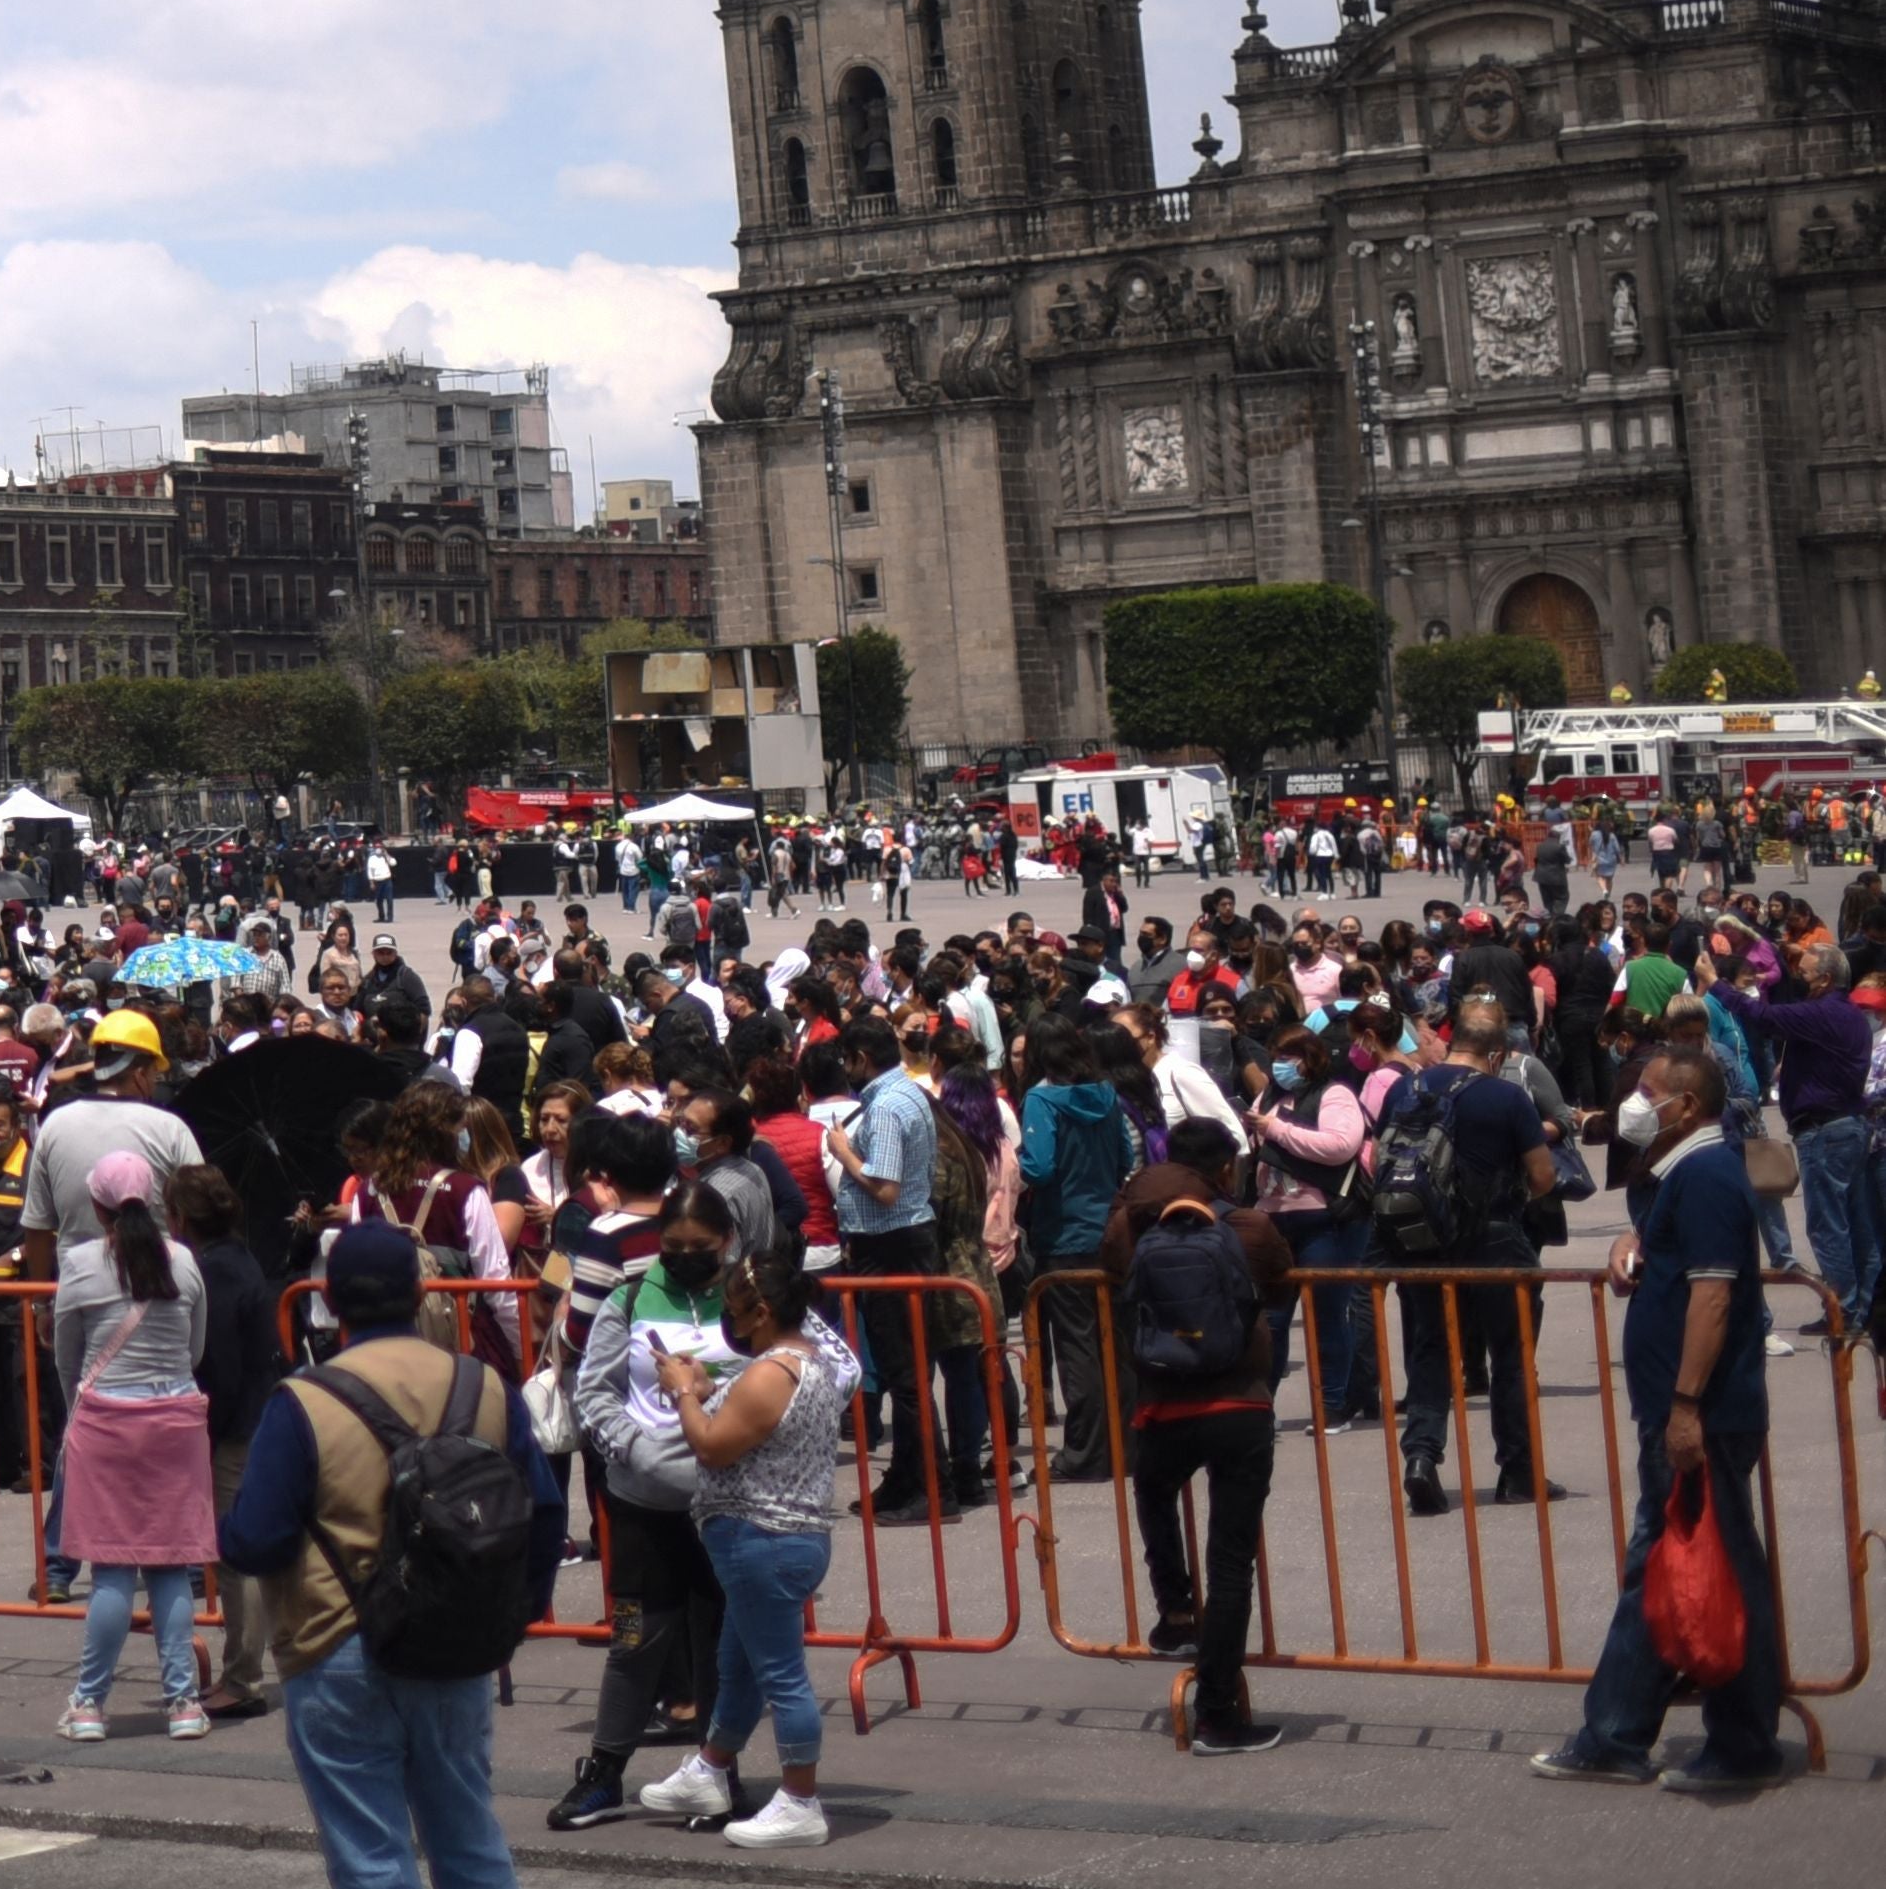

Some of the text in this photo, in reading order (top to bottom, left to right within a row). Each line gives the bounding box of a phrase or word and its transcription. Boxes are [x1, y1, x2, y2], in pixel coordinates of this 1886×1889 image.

[1287, 773, 1344, 783] AMBULANCIA
[1286, 782, 1344, 795] BOMBEROS
[1016, 813, 1034, 827] PC
